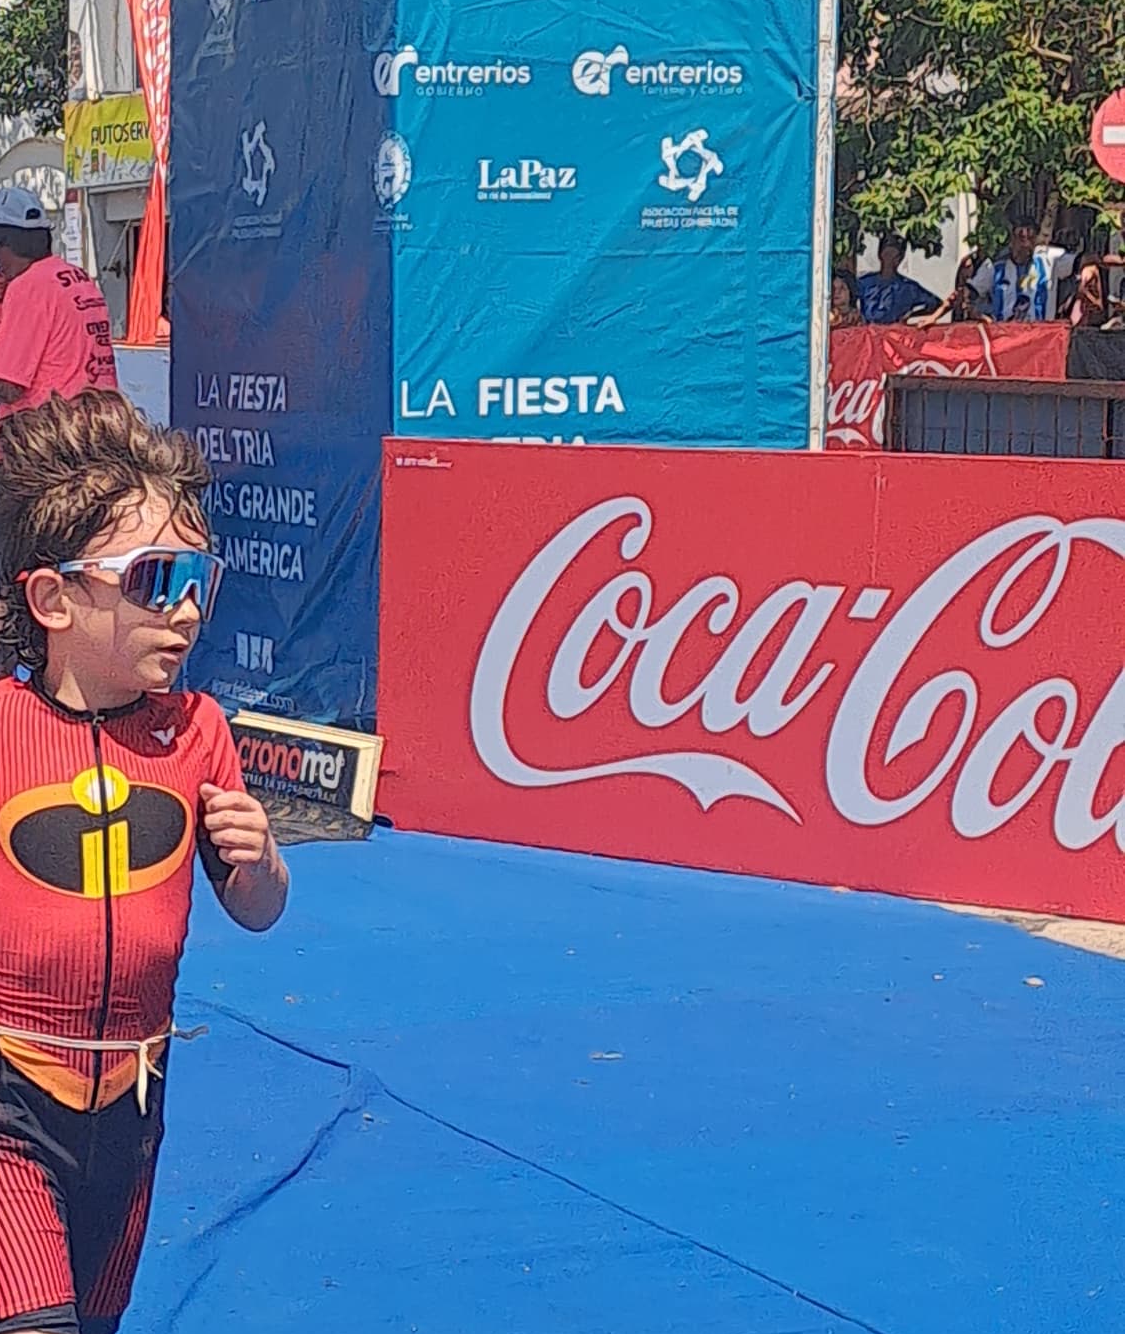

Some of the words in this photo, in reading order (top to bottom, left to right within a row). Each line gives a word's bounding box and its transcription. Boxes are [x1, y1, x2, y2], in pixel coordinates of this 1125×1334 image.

[477, 158, 577, 190] LaPaz
[196, 371, 221, 408] LA
[228, 372, 287, 412] FIESTA
[400, 379, 456, 417] LA
[478, 375, 625, 417] FIESTA
[231, 428, 274, 467] TRIA
[238, 483, 317, 527] GRANDE
[225, 530, 305, 582] AMÉRICA
[470, 495, 1125, 855] Coca-Col
